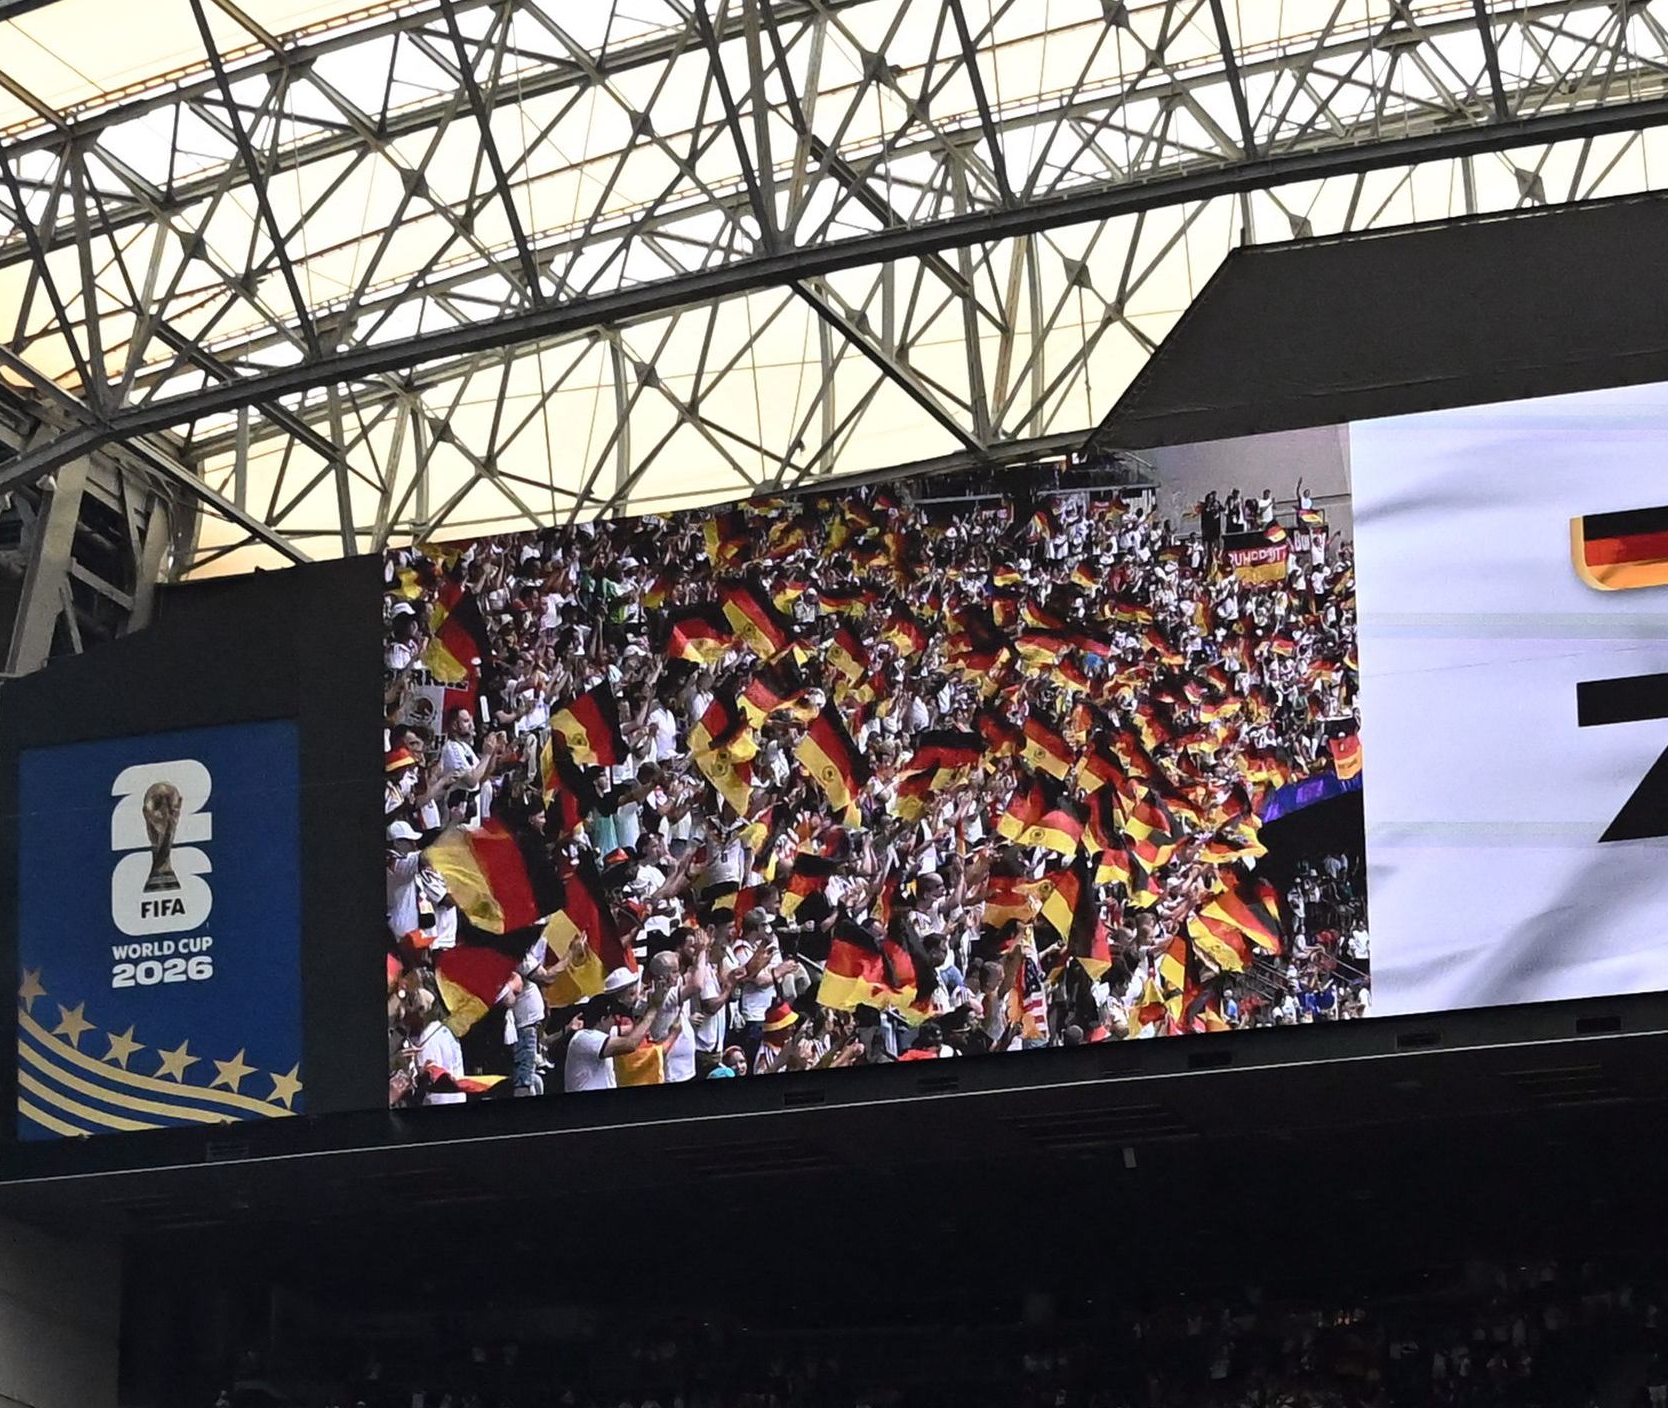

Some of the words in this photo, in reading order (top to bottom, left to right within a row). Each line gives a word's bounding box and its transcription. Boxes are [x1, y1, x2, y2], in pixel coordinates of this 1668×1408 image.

[140, 898, 186, 919] FIFA
[111, 939, 175, 961] WORLD
[178, 936, 213, 955] CUP
[112, 956, 213, 989] 2026
